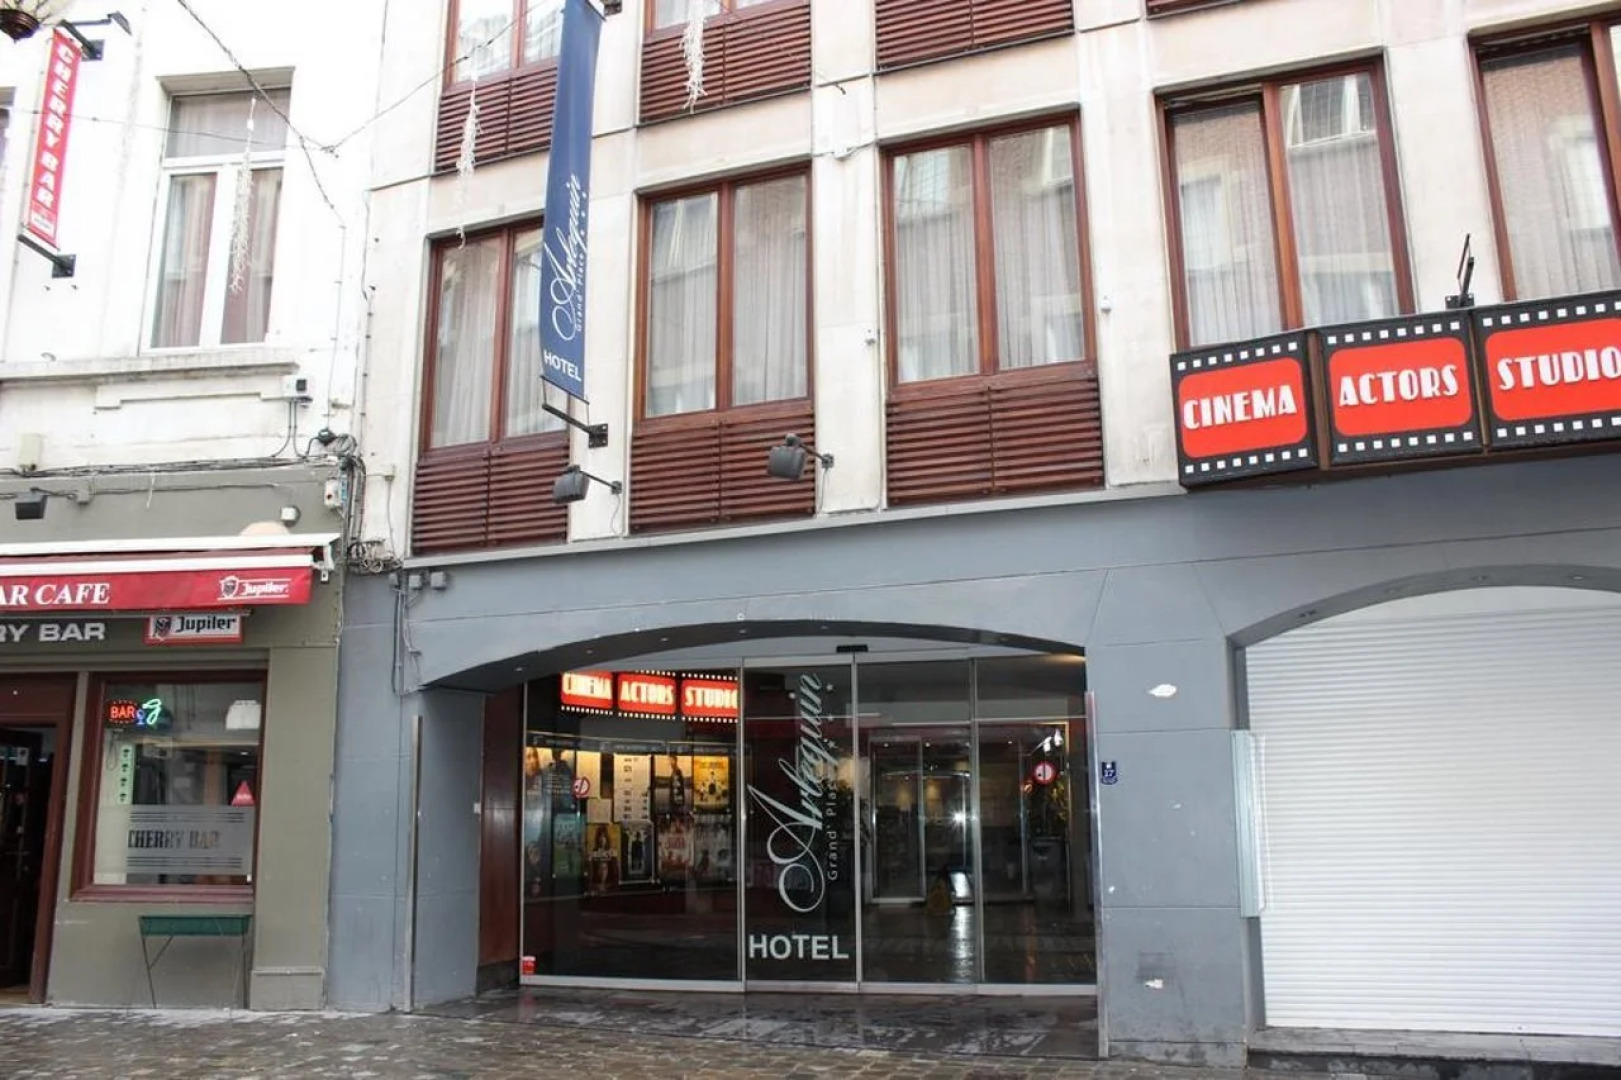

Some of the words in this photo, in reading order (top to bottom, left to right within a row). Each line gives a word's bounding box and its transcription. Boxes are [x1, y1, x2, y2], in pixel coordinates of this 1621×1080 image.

[46, 43, 74, 147] CHERRY
[37, 150, 59, 207] BAR
[543, 351, 582, 382] HOTEL
[1183, 384, 1298, 430] CINEMA
[1338, 364, 1460, 407] ACTORS
[1496, 345, 1621, 391] STUDIO
[34, 582, 110, 605] CAFE
[39, 622, 105, 642] BAR
[176, 615, 237, 633] Jupiler
[562, 673, 613, 699] CINEMA
[620, 680, 675, 705] ACTORS
[110, 705, 135, 719] BAR
[748, 934, 850, 960] HOTEL
